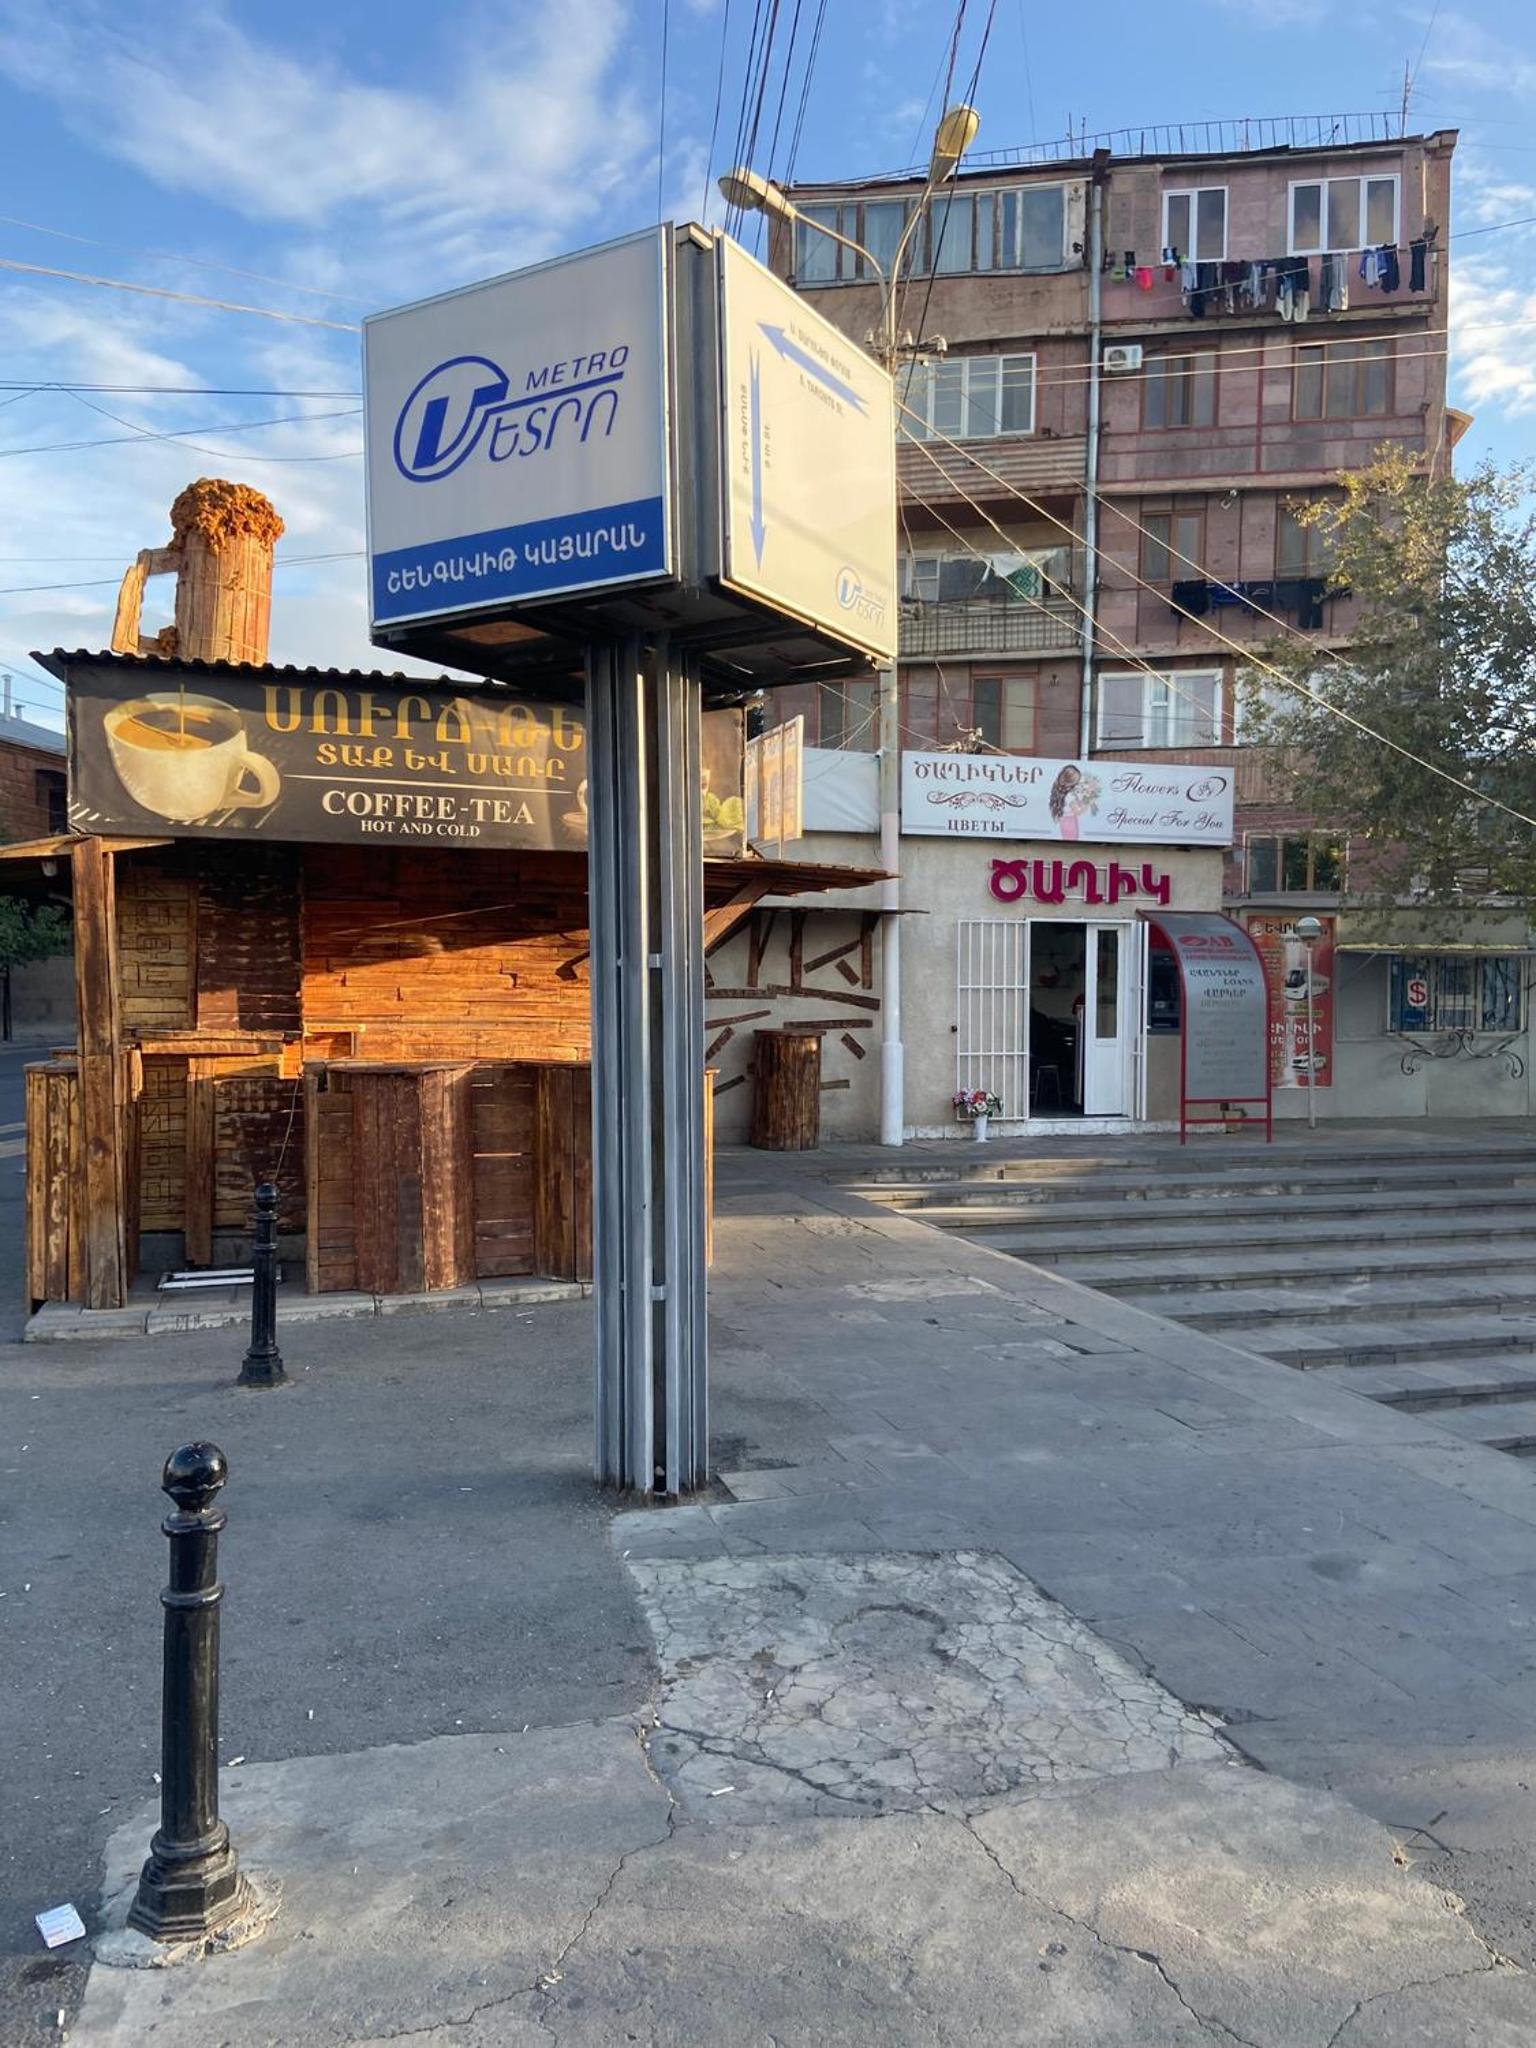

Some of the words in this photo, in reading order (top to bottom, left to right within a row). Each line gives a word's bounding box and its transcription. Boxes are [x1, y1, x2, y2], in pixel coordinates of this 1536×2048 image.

[526, 345, 629, 391] METRO
[387, 546, 518, 594] ՇԵՆԳԱՎԻԹ
[524, 523, 646, 566] ԿԱՅԱՐԱՆ
[263, 685, 585, 752] ՍՈՒՐՃ-ԹԵ
[316, 743, 394, 768] ՏԱՔ
[404, 748, 457, 774] ԵՎ
[913, 760, 1044, 784] ԾԱՂԻԿՆԵՐ
[1111, 772, 1180, 796] Flowers
[361, 819, 397, 834] HOT
[399, 822, 433, 836] AND
[436, 823, 481, 838] COLD
[947, 819, 1005, 834] ЦВЕТЫ
[1106, 807, 1159, 830] Special
[1159, 810, 1189, 827] For
[1192, 811, 1224, 831] You
[989, 858, 1171, 905] ԾԱՂԻԿ
[1409, 981, 1427, 1005] $
